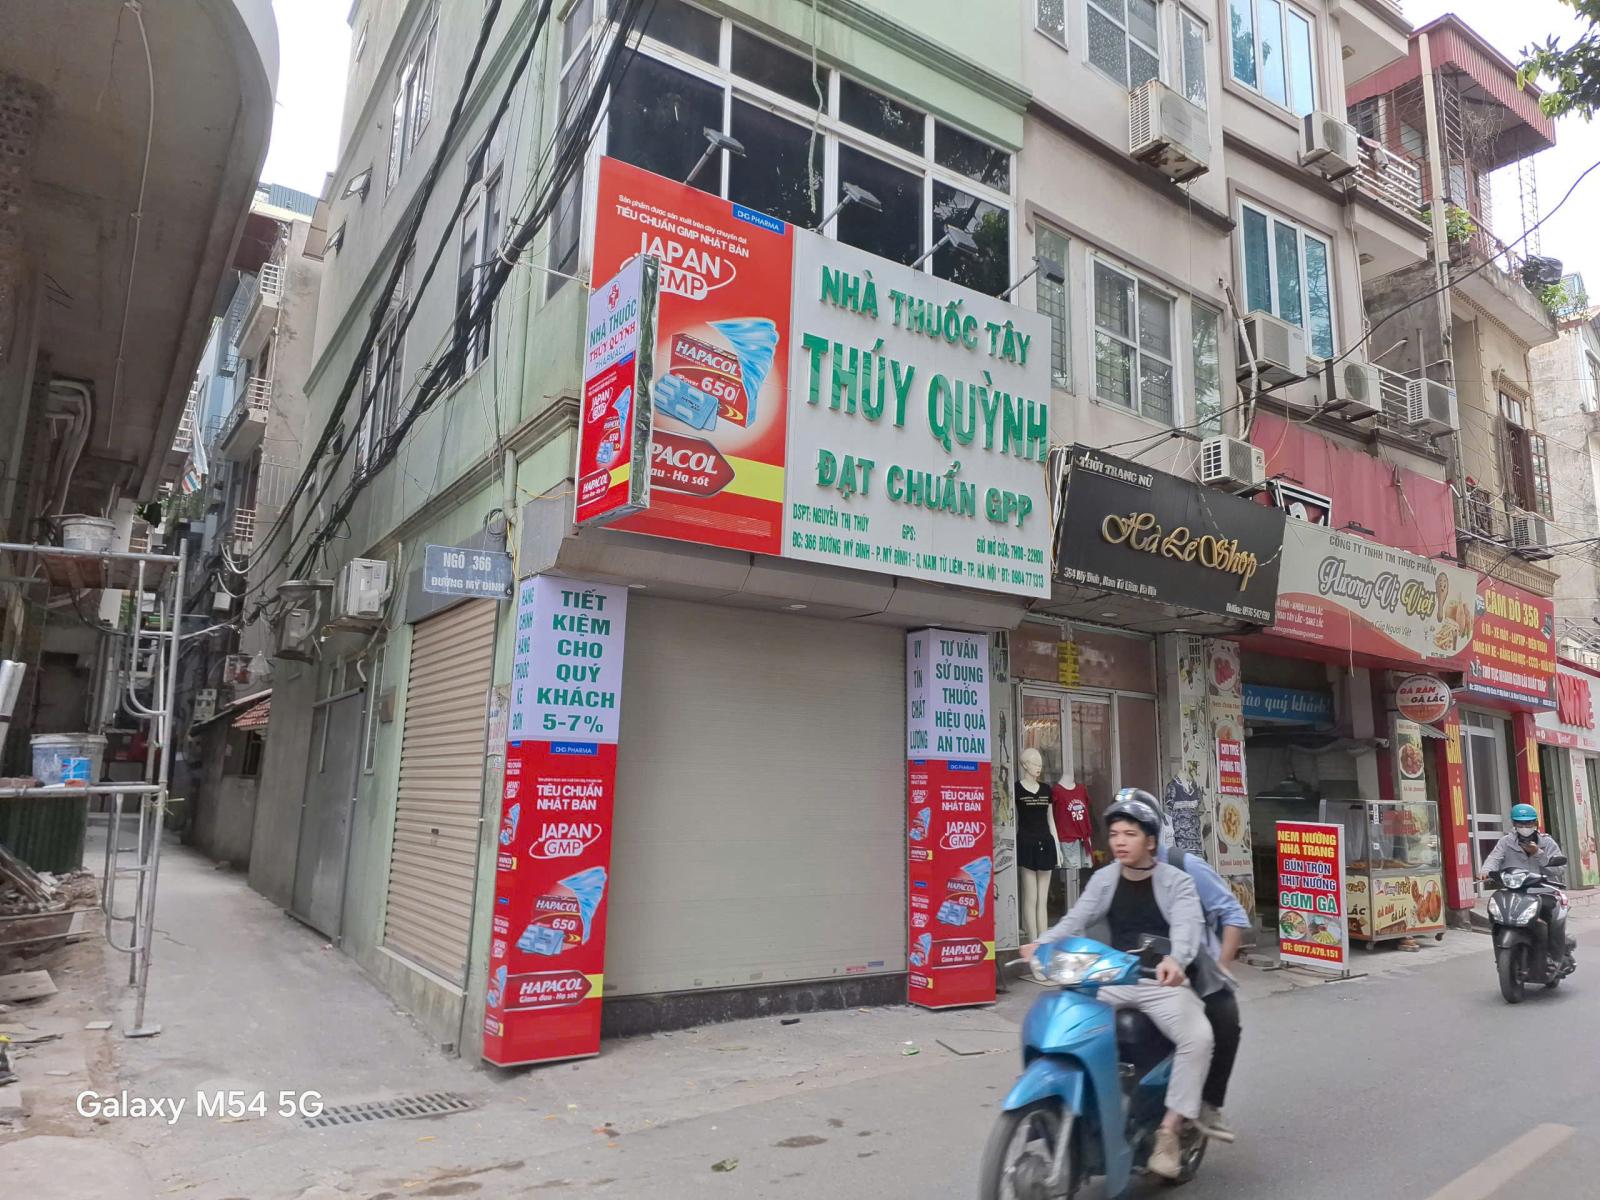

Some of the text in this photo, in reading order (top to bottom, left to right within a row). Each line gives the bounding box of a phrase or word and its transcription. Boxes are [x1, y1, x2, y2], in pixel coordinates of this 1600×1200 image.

[616, 204, 749, 258] TIÊU CHUẨN GMP NHẬT BẢN
[751, 213, 779, 231] PHARMA
[589, 295, 637, 348] NHÀ THUỐC
[819, 265, 1031, 366] NHÀ THUỐC TÂY
[676, 341, 739, 376] HAPACOL
[701, 377, 736, 401] 650
[801, 332, 1047, 464] THÚY QUỲNH
[652, 442, 718, 475] PACOL
[673, 470, 689, 484] Hạ
[692, 475, 709, 487] sốt
[1105, 464, 1137, 483] TRANG
[1138, 474, 1153, 487] NỮ
[816, 448, 1032, 528] ĐẠT CHUẨN GPP
[793, 503, 811, 521] DSPT:
[813, 505, 839, 527] NGUYỄN
[443, 551, 492, 571] NGÕ 366
[804, 533, 816, 550] 366
[923, 554, 937, 571] NAM
[1329, 535, 1351, 550] CÔNG
[1353, 543, 1362, 554] TY
[1364, 546, 1383, 560] TNHH
[1385, 553, 1396, 565] TM
[1398, 556, 1416, 570] THỰC
[1199, 535, 1257, 592] Shop
[1319, 556, 1437, 621] Hương Vị Việt
[561, 589, 607, 612] TIẾT
[1484, 588, 1539, 629] CẦM ĐỒ 358
[552, 613, 611, 637] KIỆM
[557, 639, 603, 659] CHO
[914, 640, 922, 658] UY
[940, 637, 978, 660] TƯ VẤN
[556, 662, 601, 684] QUÝ
[914, 666, 922, 689] TÍN
[936, 659, 984, 685] SỬ DỤNG
[537, 686, 615, 709] KHÁCH
[942, 683, 978, 706] THUỐC
[542, 713, 604, 733] 5-7%
[935, 708, 986, 732] HIỆU QUẢ
[937, 733, 985, 754] AN TOÀN
[537, 783, 603, 797] TIÊU CHUẨN
[940, 790, 957, 800] TIÊU
[957, 789, 984, 801] CHUẨN
[537, 797, 596, 811] NHẬT BẢN
[965, 801, 981, 812] BẢN
[538, 823, 592, 842] JAPAN
[945, 821, 980, 836] JAPAN
[1277, 830, 1337, 846] NEM NƯỚNG
[547, 842, 581, 854] GMP
[951, 836, 974, 847] GMP
[1280, 843, 1335, 858] NHA TRANG
[1284, 858, 1331, 877] BÚN TRỘN
[1280, 874, 1336, 891] THỊT NƯỚNG
[536, 900, 578, 912] HAPACOL
[959, 896, 975, 906] 650
[1280, 891, 1338, 914] CƠM GÀ
[552, 918, 576, 931] 650
[941, 944, 982, 956] HAPACOL
[519, 978, 582, 995] HAPACOL
